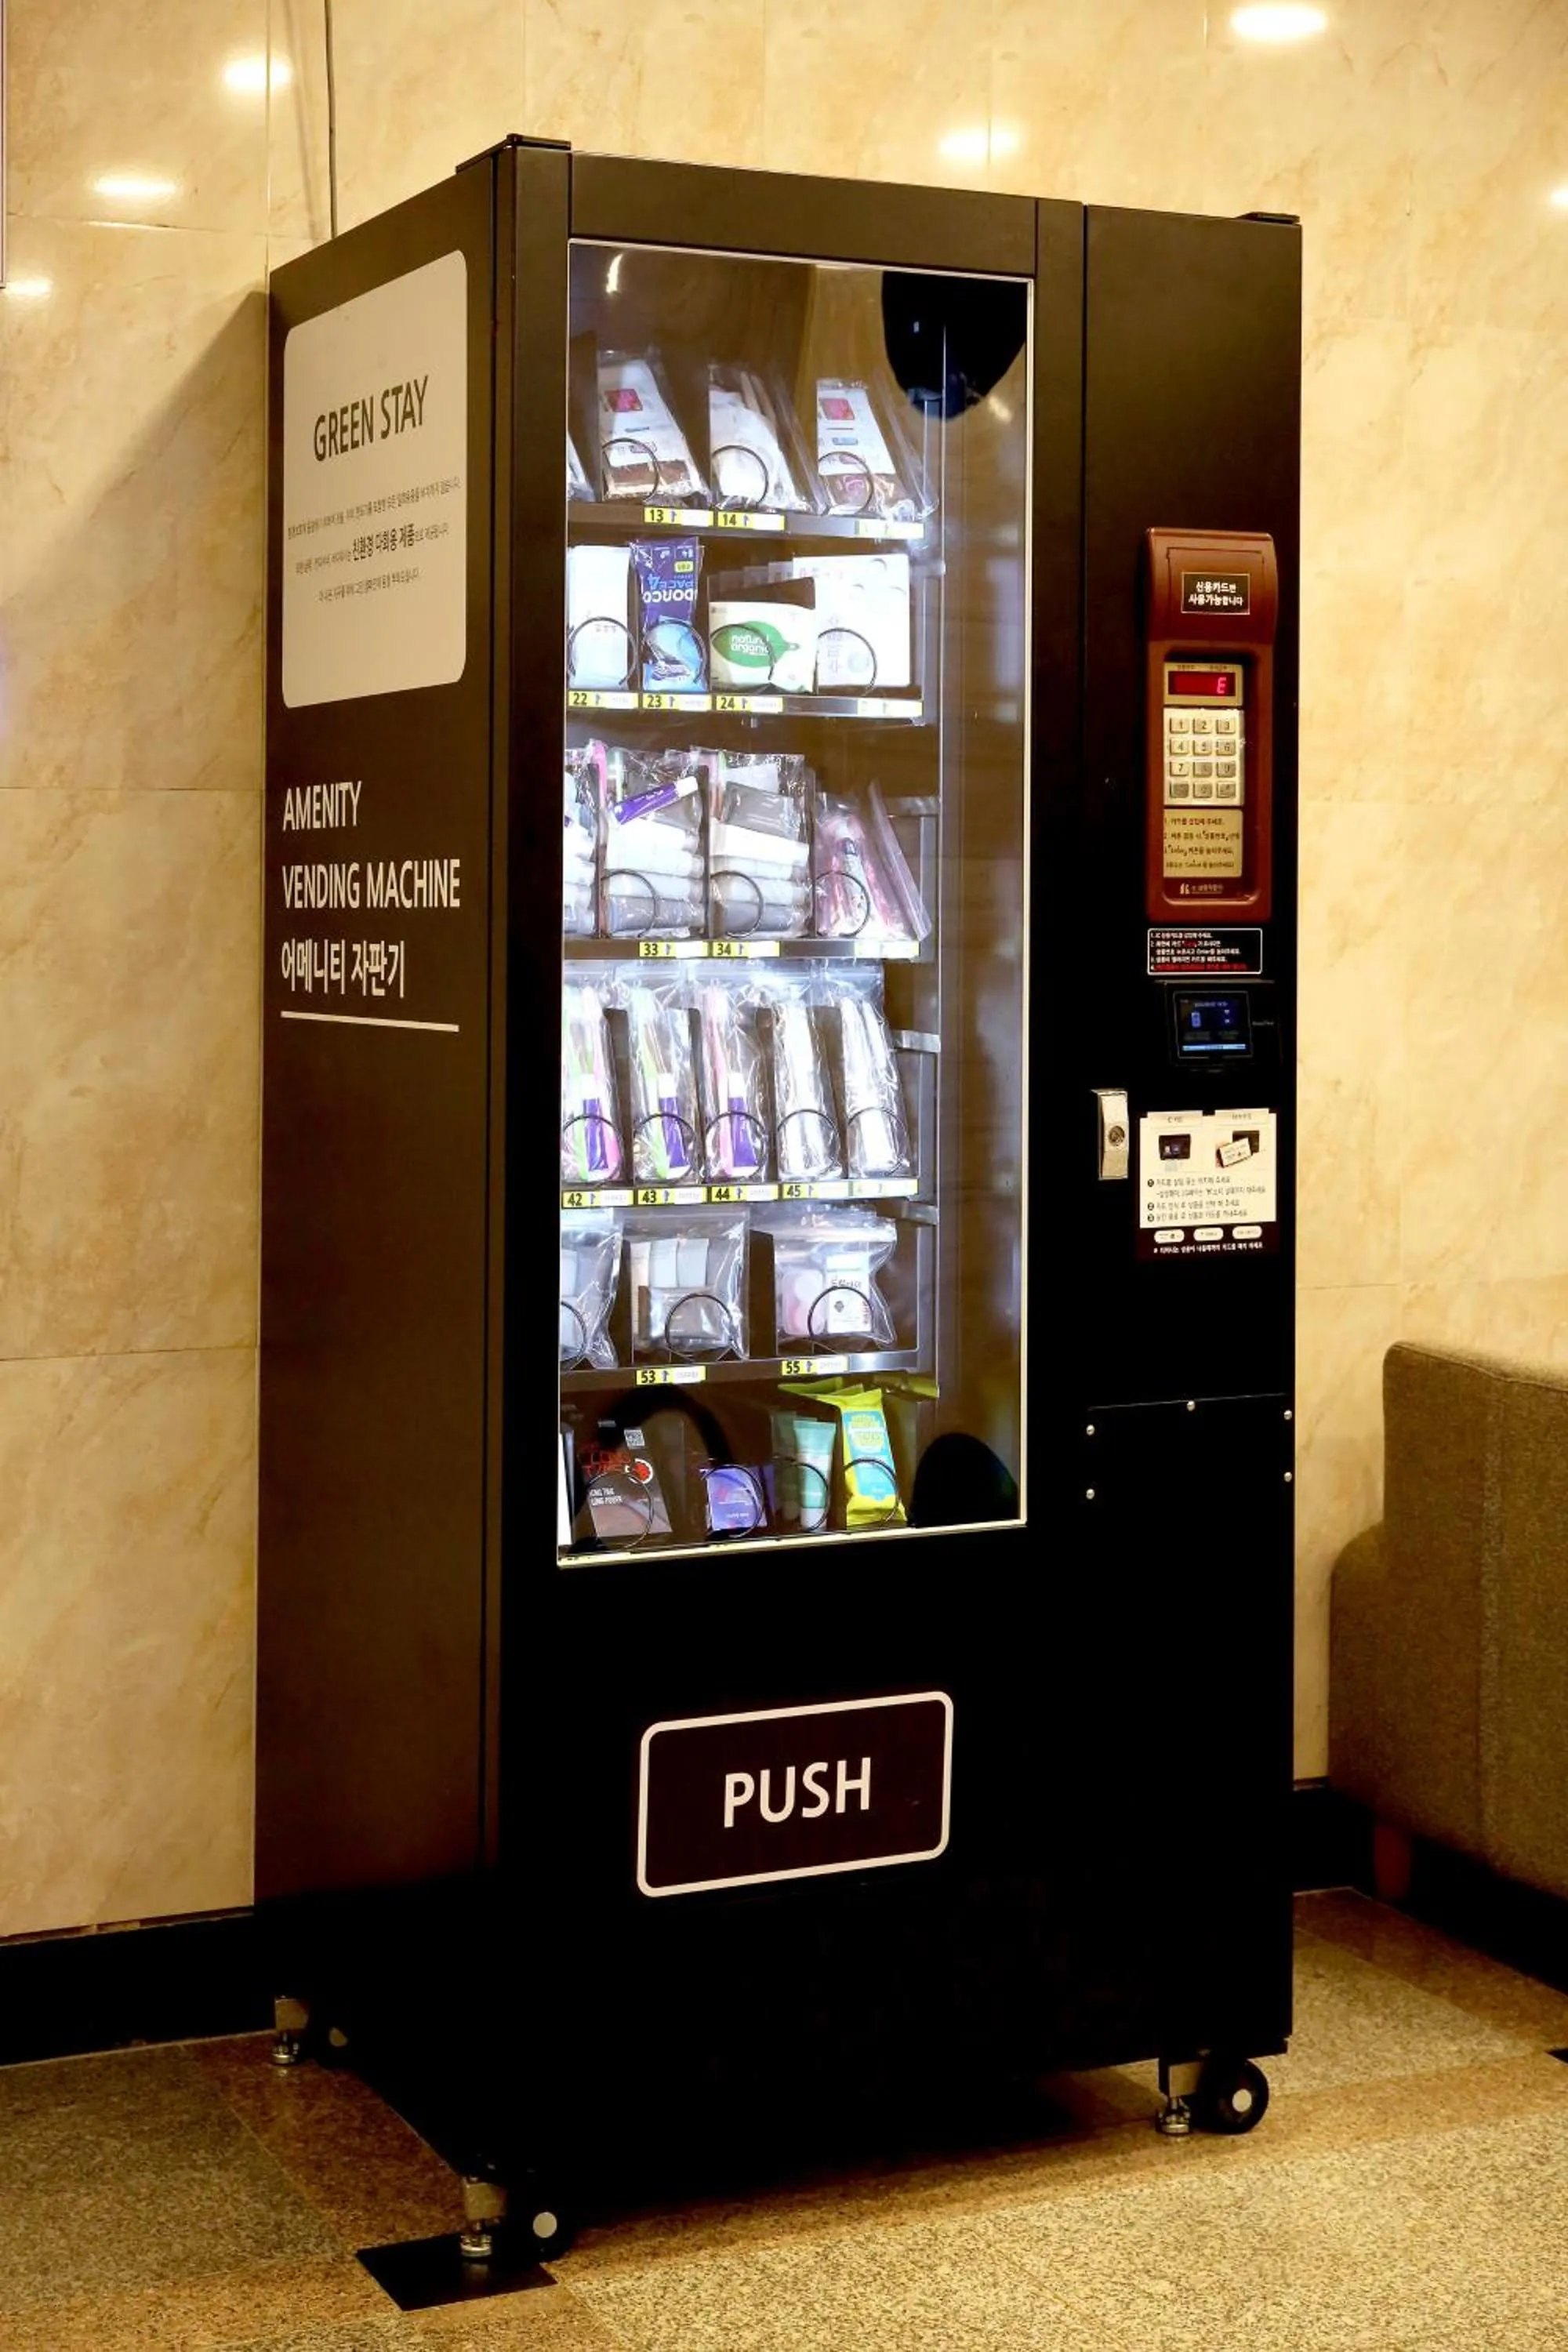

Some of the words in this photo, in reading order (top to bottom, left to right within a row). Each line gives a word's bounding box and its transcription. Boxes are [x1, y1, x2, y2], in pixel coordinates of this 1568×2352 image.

[314, 395, 373, 461] GREEN
[381, 375, 428, 439] STAY
[650, 508, 663, 521] 13
[723, 514, 736, 526] 14
[1217, 677, 1227, 694] E
[573, 693, 587, 706] 22
[648, 695, 662, 707] 23
[720, 697, 735, 710] 24
[283, 781, 362, 831] AMENITY
[281, 862, 360, 909] VENDING
[366, 858, 460, 909] MACHINE
[644, 943, 659, 956] 33
[717, 943, 731, 956] 34
[281, 938, 346, 996] 어메니티
[350, 940, 405, 999] 자판기
[642, 1190, 657, 1203] 43
[715, 1188, 730, 1200] 44
[787, 1185, 801, 1197] 45
[567, 1193, 583, 1206] 42
[786, 1361, 800, 1374] 55
[641, 1370, 655, 1384] 53
[724, 1757, 871, 1828] PUSH
